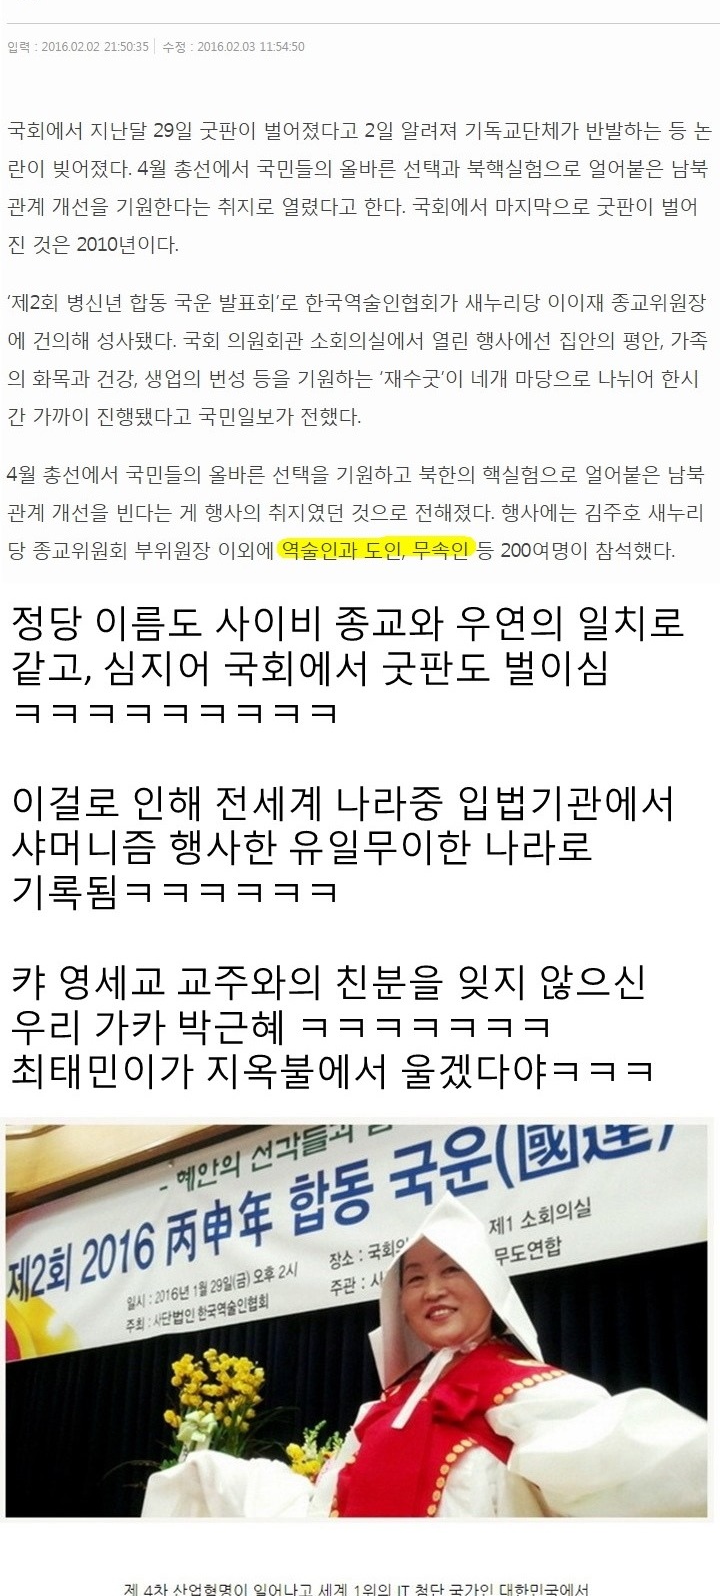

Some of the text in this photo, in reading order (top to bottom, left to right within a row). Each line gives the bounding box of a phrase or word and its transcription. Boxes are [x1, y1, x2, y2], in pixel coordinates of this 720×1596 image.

[7, 41, 150, 54] 입력 2016.02.02 21:50:35
[162, 41, 305, 54] 수정 2016.02.03 11:54:50
[176, 1154, 241, 1193] 혜안의
[7, 1242, 73, 1303] 제2회
[80, 1222, 155, 1285] 2016
[166, 1190, 273, 1267] 丙申年
[289, 1158, 375, 1237] 합동
[489, 1196, 592, 1237] 제1 소회의실
[329, 1251, 355, 1271] 장소
[126, 1261, 299, 1311] 일시 2016년 1월 29일(금) 오후 2시
[330, 1274, 357, 1297] 주관
[126, 1293, 270, 1333] 주최 사단법인 한국역술인협회
